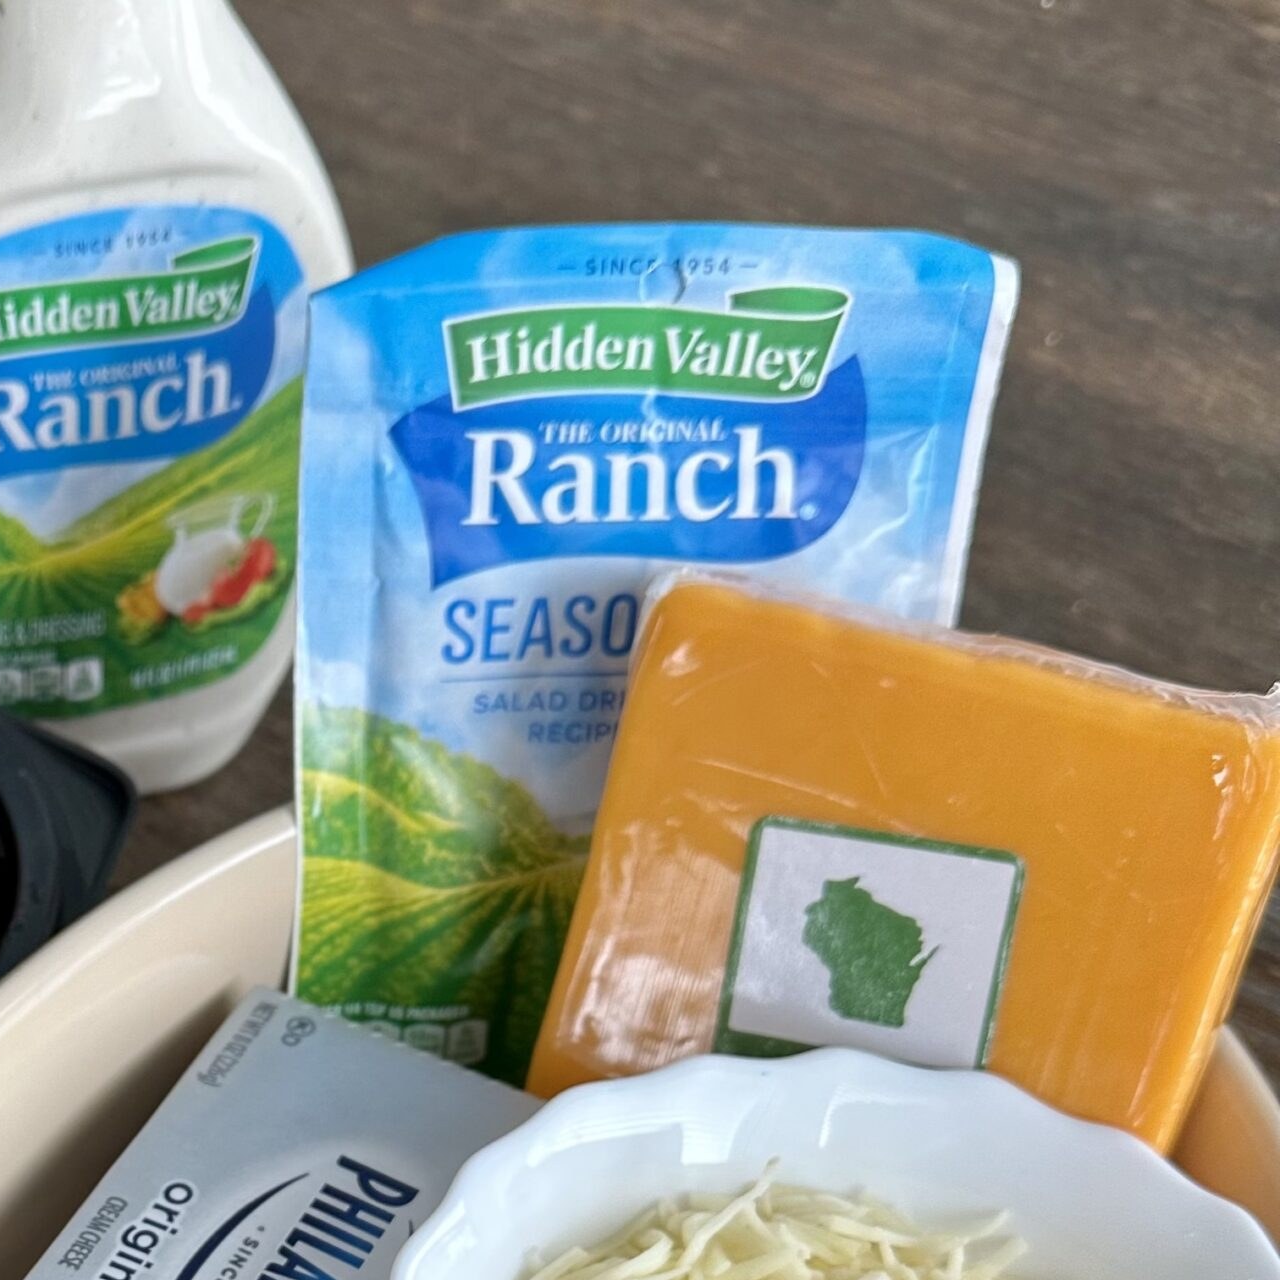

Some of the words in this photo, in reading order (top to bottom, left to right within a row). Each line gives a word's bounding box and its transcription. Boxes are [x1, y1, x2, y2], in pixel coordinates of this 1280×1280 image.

[586, 258, 657, 276] SINCE
[672, 257, 731, 276] 1954
[466, 321, 654, 384] Hidden
[540, 421, 593, 444] THE
[599, 420, 729, 443] ORIGINAL
[461, 426, 798, 526] Ranch
[440, 592, 639, 665] SEASO
[473, 691, 567, 715] SALAD
[578, 689, 626, 712] DR
[527, 722, 619, 746] RECIP
[86, 1196, 128, 1234] CREAM
[57, 1231, 102, 1271] CHEESE
